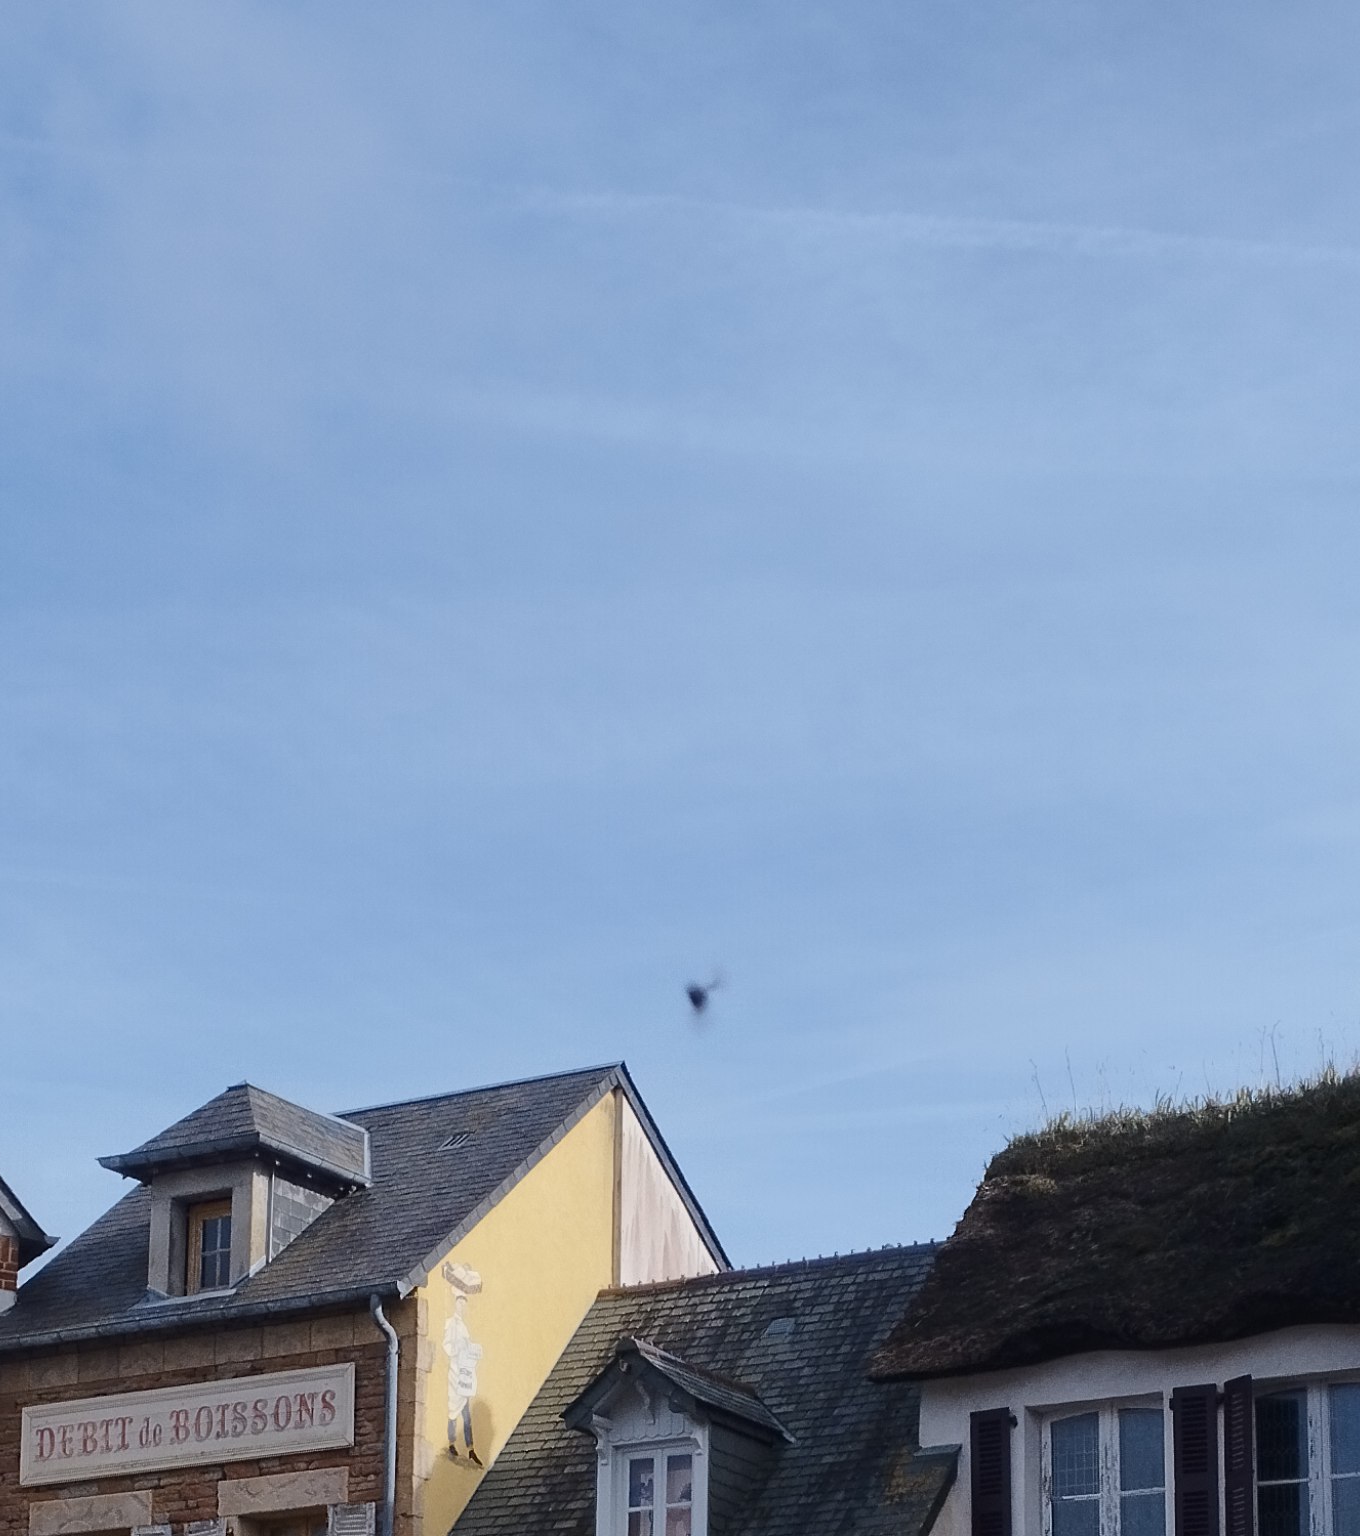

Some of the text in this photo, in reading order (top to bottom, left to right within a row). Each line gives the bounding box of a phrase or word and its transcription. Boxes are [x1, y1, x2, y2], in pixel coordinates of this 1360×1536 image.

[35, 1389, 337, 1462] DEBIT de BOISSONS
